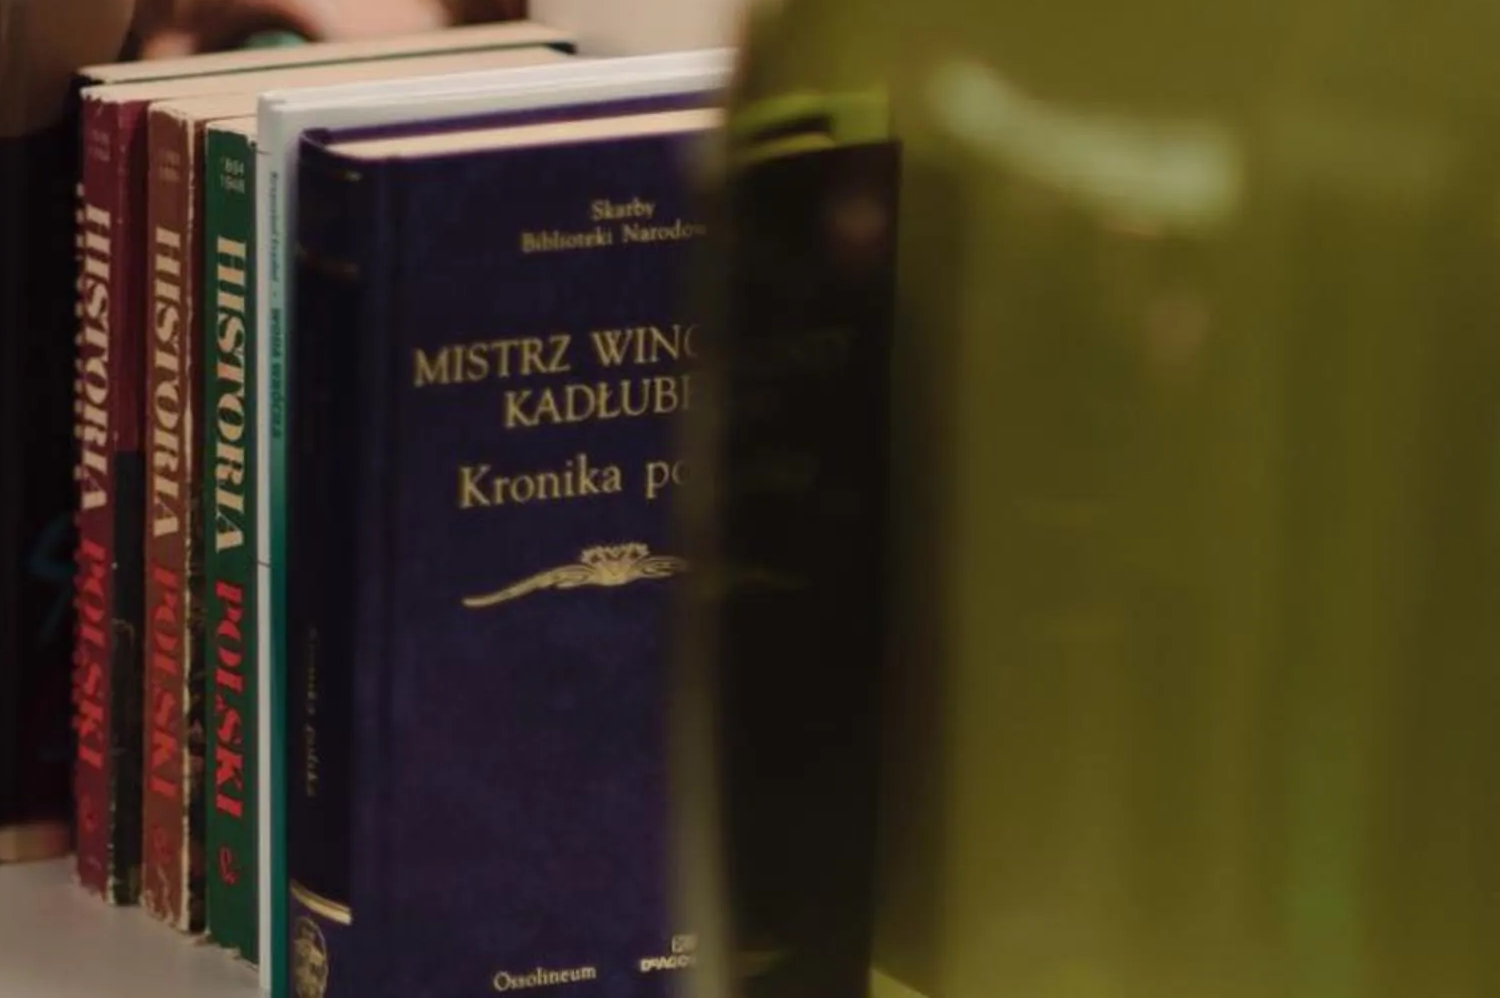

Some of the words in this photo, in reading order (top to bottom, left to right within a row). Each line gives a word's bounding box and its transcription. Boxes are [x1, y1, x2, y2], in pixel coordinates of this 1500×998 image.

[521, 227, 613, 254] Biblioteki
[622, 218, 707, 243] Narodow
[591, 197, 656, 222] Skarby
[83, 204, 111, 510] HISTORIA
[152, 227, 181, 537] HISTORIA
[215, 235, 247, 554] HISTORIA
[413, 333, 572, 388] MISTRZ
[591, 324, 700, 367] WINC
[504, 375, 692, 429] KADŁUB
[459, 454, 623, 509] Kronika
[78, 539, 106, 769] POLSKI
[152, 560, 182, 798] POLSKI
[215, 580, 245, 818] POLSKI
[493, 965, 598, 992] Ossolineum
